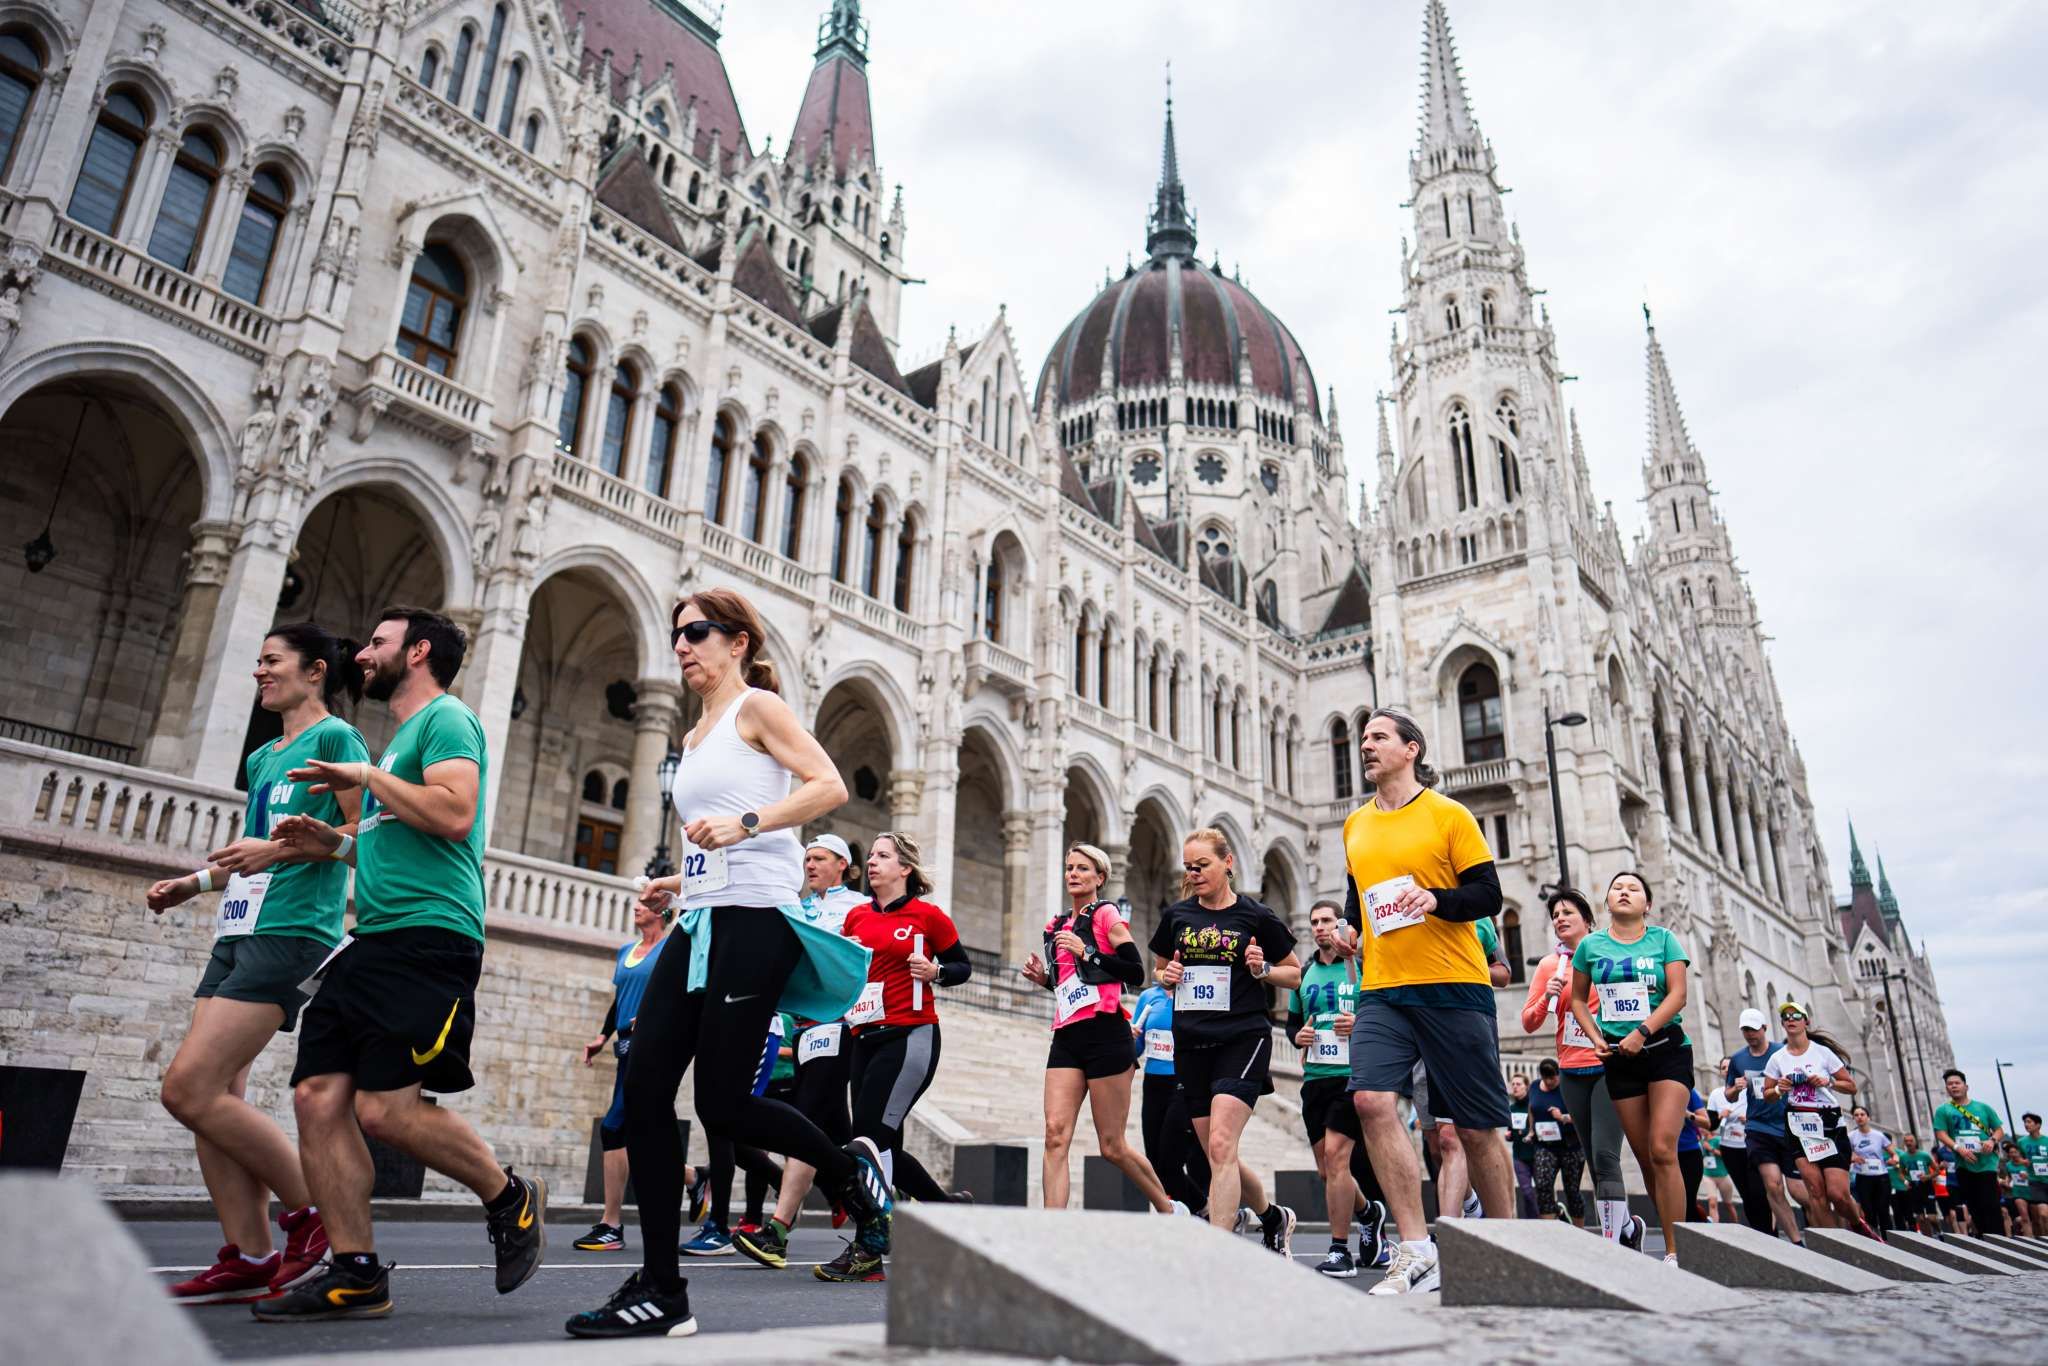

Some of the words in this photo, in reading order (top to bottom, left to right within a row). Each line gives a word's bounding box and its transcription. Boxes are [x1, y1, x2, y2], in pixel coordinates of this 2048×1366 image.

[269, 780, 296, 805] év
[1597, 956, 1633, 985] 21
[1067, 984, 1090, 1006] 1565
[1192, 984, 1215, 1000] 193
[1306, 981, 1336, 1013] 21
[1614, 999, 1640, 1012] 1852
[809, 1037, 830, 1052] 1750
[1319, 1044, 1338, 1056] 833
